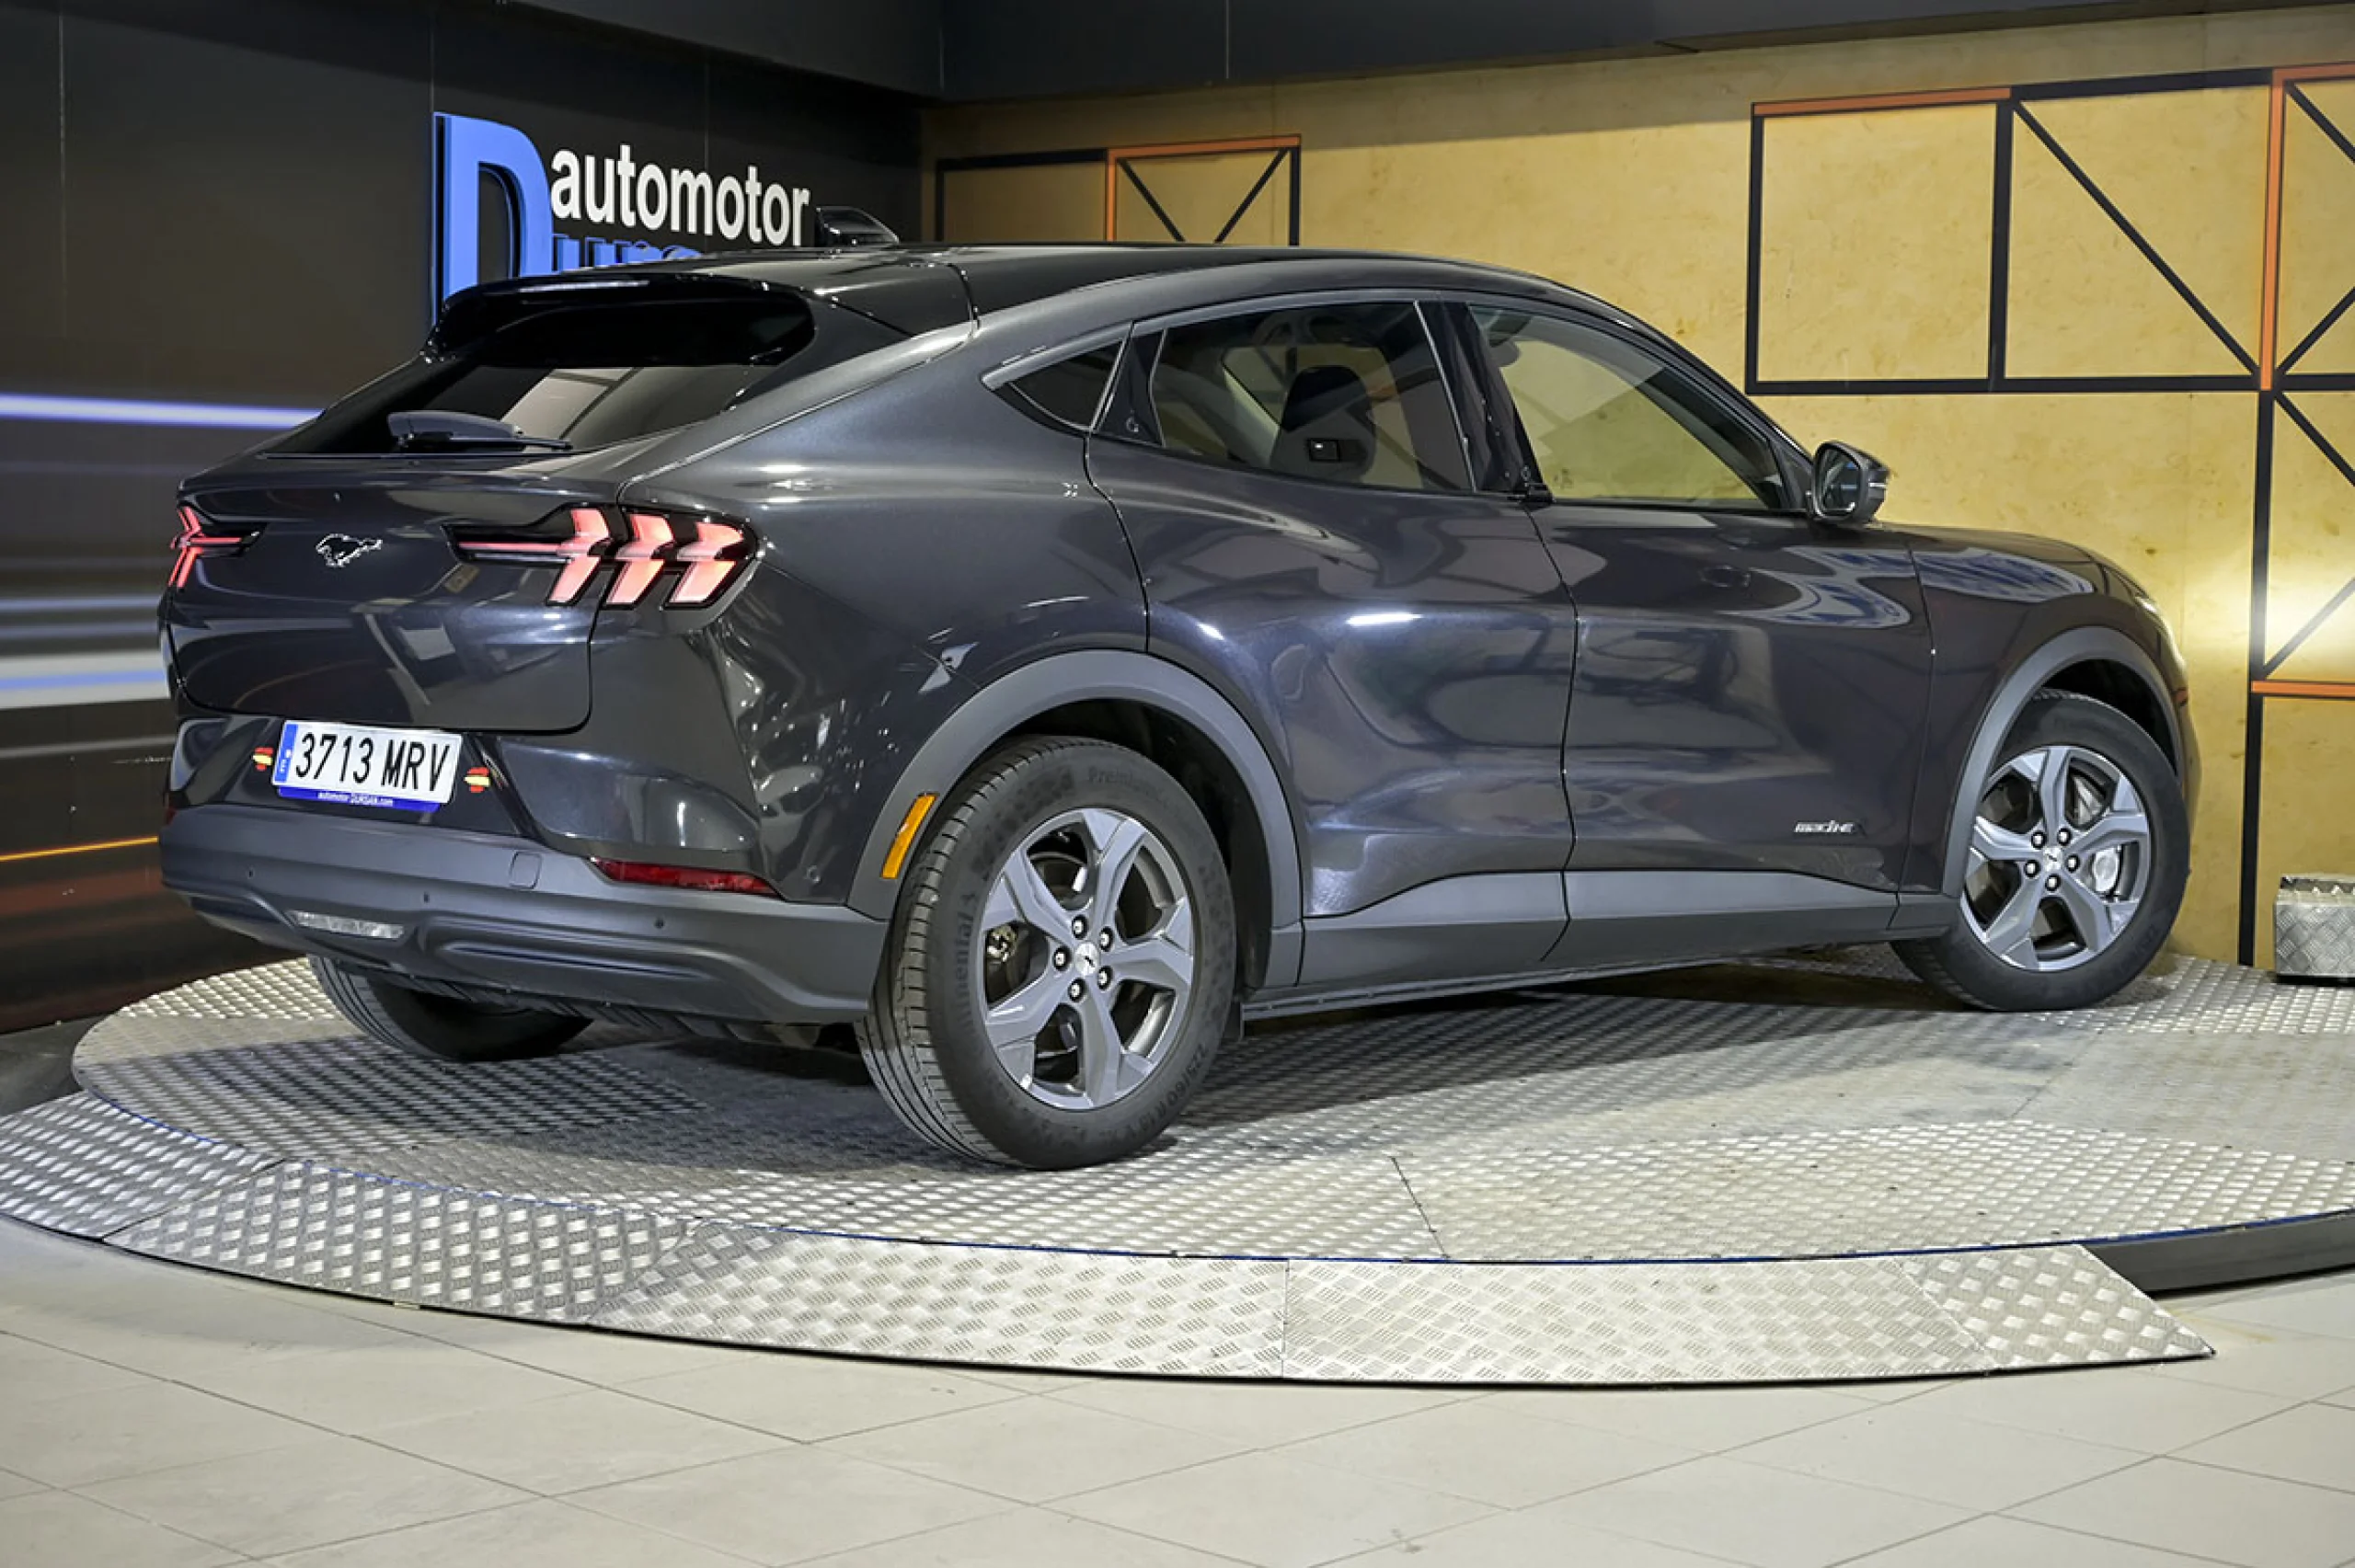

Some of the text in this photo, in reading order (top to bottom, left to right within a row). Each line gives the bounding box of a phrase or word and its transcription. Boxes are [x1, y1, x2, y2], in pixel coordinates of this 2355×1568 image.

[551, 143, 810, 246] automotor
[295, 732, 451, 792] 3713 MRV
